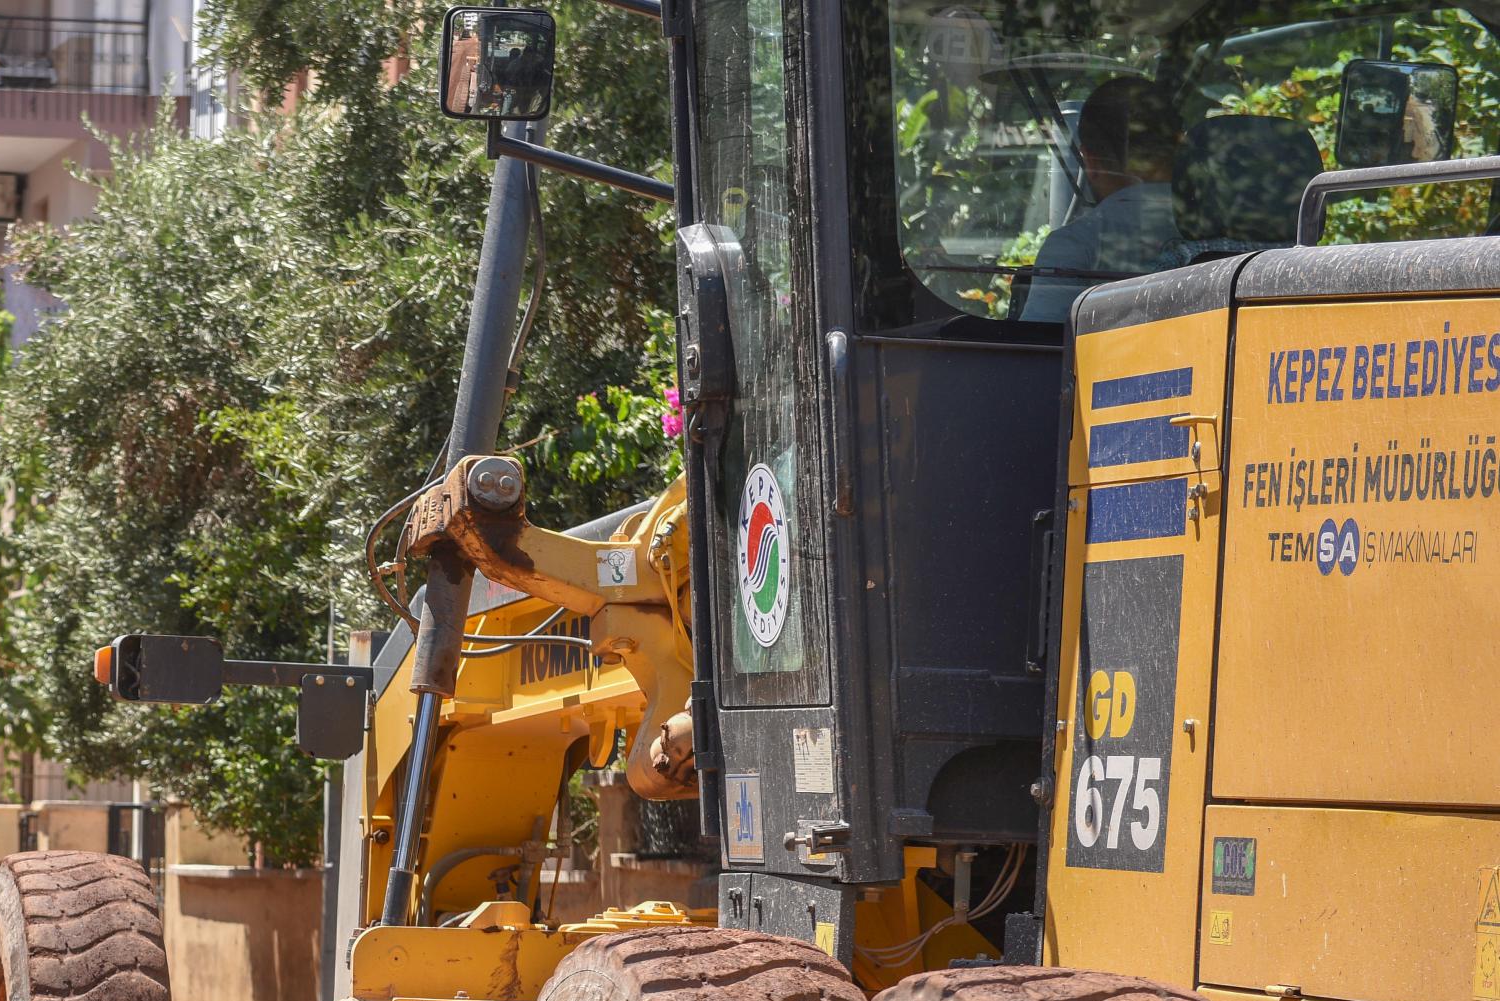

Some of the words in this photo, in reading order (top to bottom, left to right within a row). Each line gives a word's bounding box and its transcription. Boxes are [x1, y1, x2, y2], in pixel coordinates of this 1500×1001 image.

[1268, 347, 1348, 405] KEPEZ
[741, 476, 785, 536] KEPEZ
[1243, 462, 1283, 508] FEN
[1287, 442, 1359, 513] İŞLERİ
[1363, 434, 1500, 503] MÜDÜRLÜĞ
[1268, 531, 1358, 563] TEMSA
[1362, 525, 1377, 569] İŞ
[1379, 525, 1478, 564] MAKİNALARI
[1085, 670, 1136, 740] GD
[1075, 755, 1161, 850] 675
